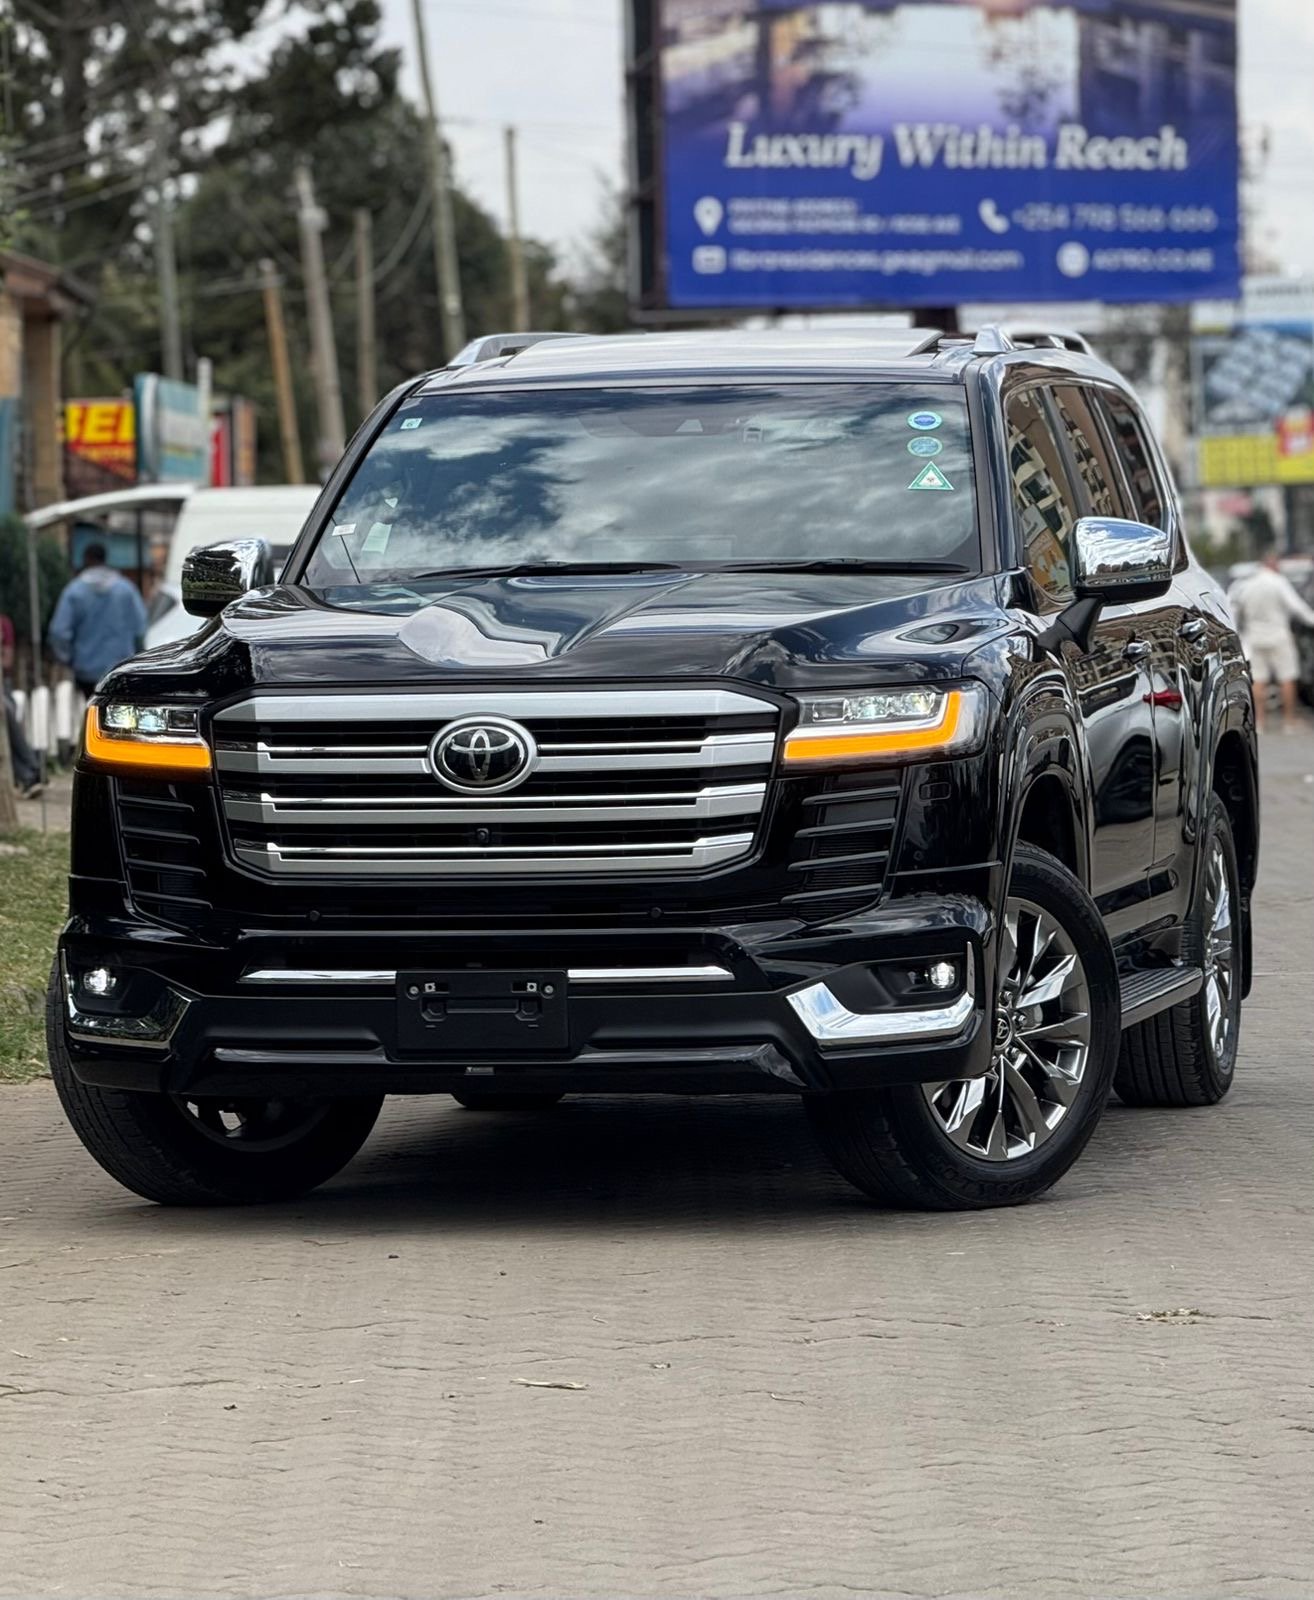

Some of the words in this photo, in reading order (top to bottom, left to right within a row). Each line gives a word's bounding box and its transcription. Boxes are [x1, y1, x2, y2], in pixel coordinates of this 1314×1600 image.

[724, 121, 883, 181] Luxury
[894, 122, 1048, 170] Within
[1054, 124, 1189, 172] Reach
[1013, 202, 1070, 231] +254
